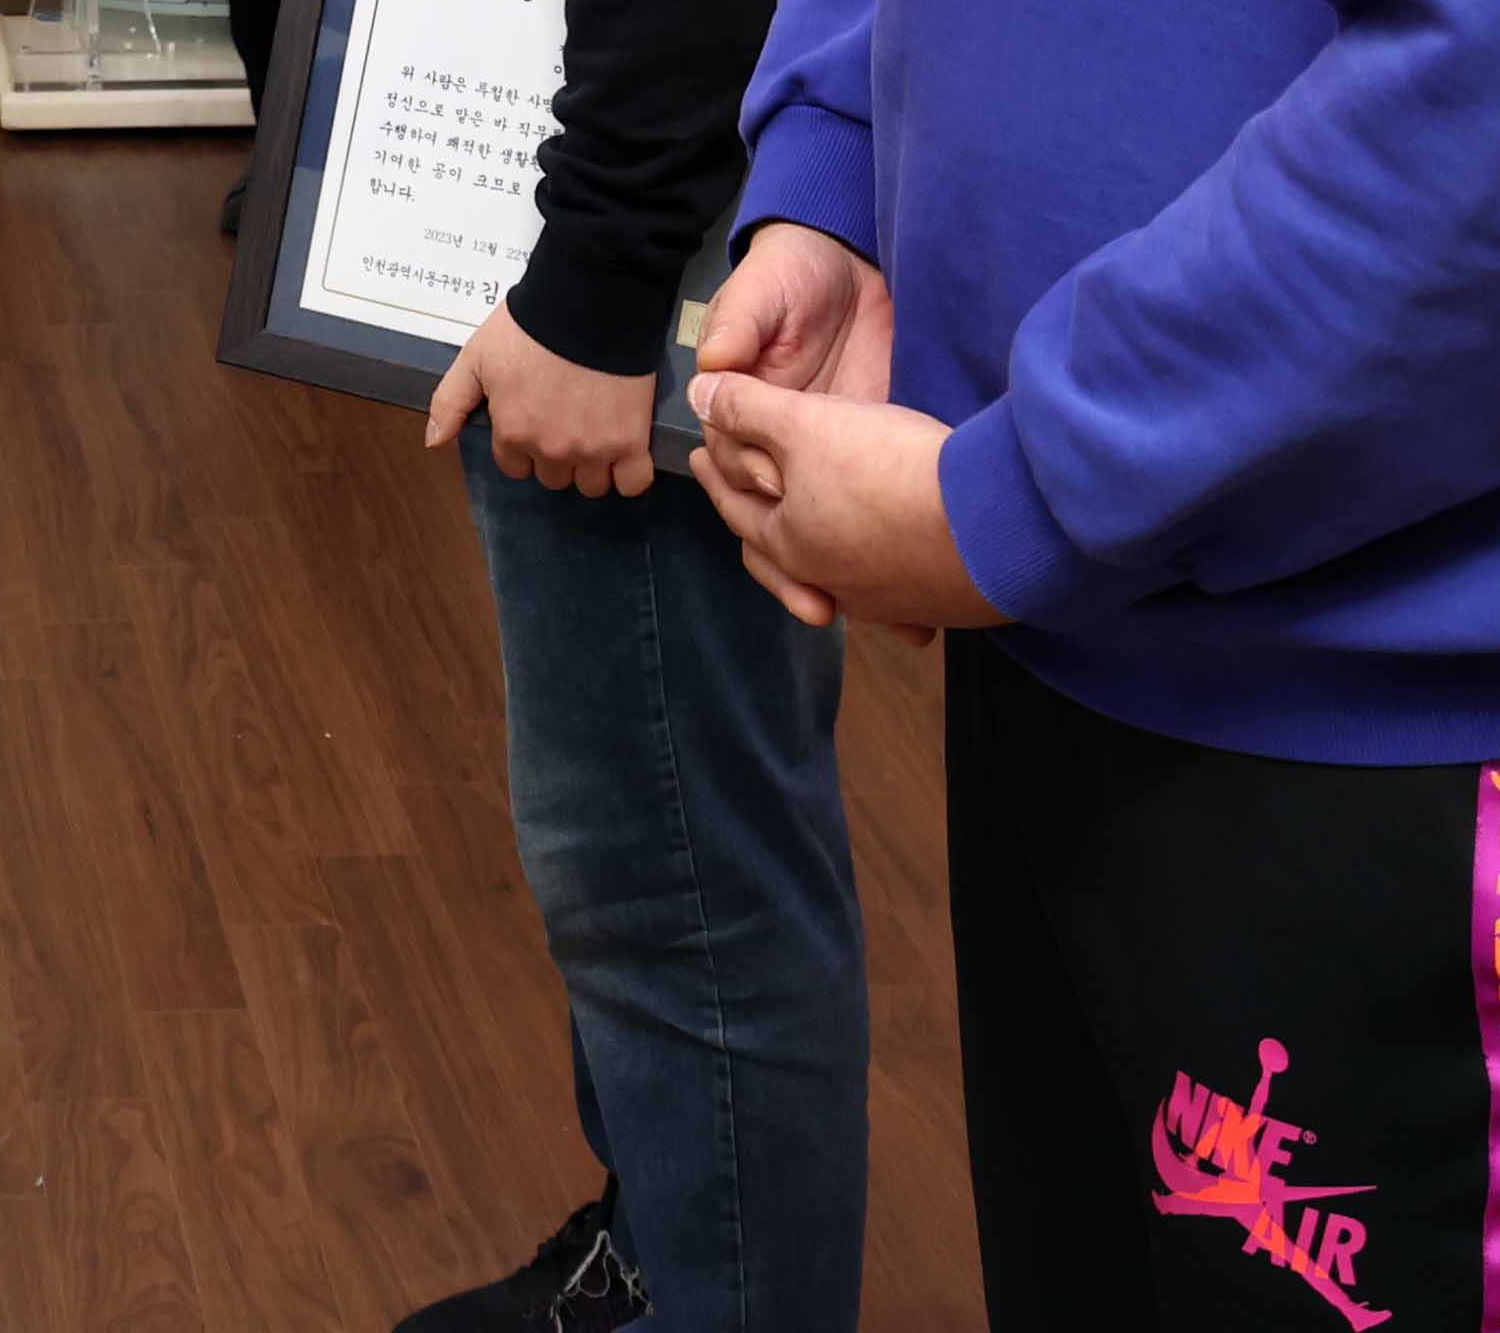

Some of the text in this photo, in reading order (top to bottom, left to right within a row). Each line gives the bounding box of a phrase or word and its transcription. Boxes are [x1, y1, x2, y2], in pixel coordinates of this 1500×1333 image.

[423, 70, 468, 93] 사람은
[384, 91, 445, 118] 정신으로
[379, 121, 438, 145] 수행하여
[374, 149, 522, 196] 기여한 공이 크므로
[423, 228, 465, 249] 2023년
[1240, 1206, 1368, 1287] AIR
